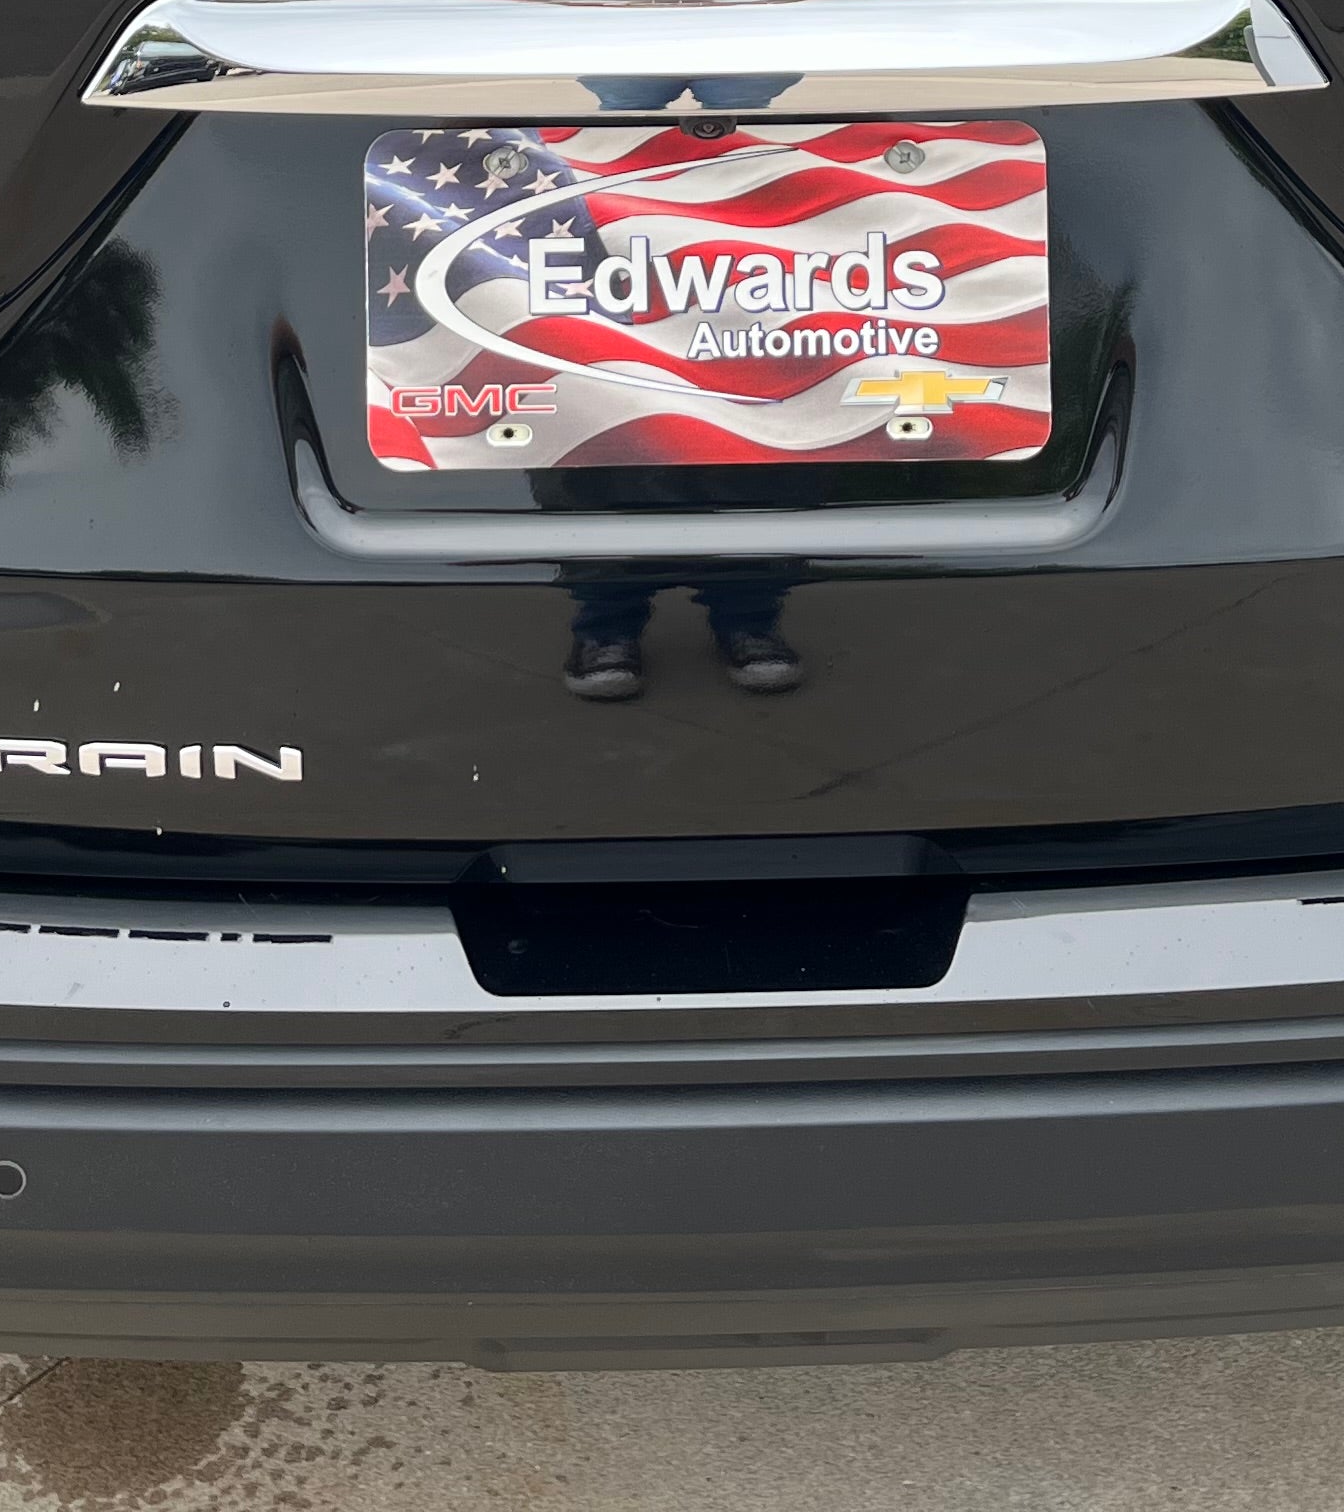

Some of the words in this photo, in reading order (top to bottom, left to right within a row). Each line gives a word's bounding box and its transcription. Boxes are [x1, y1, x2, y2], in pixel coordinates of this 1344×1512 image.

[527, 231, 946, 316] Edwards
[687, 317, 940, 360] Automotive
[389, 382, 558, 417] GMC
